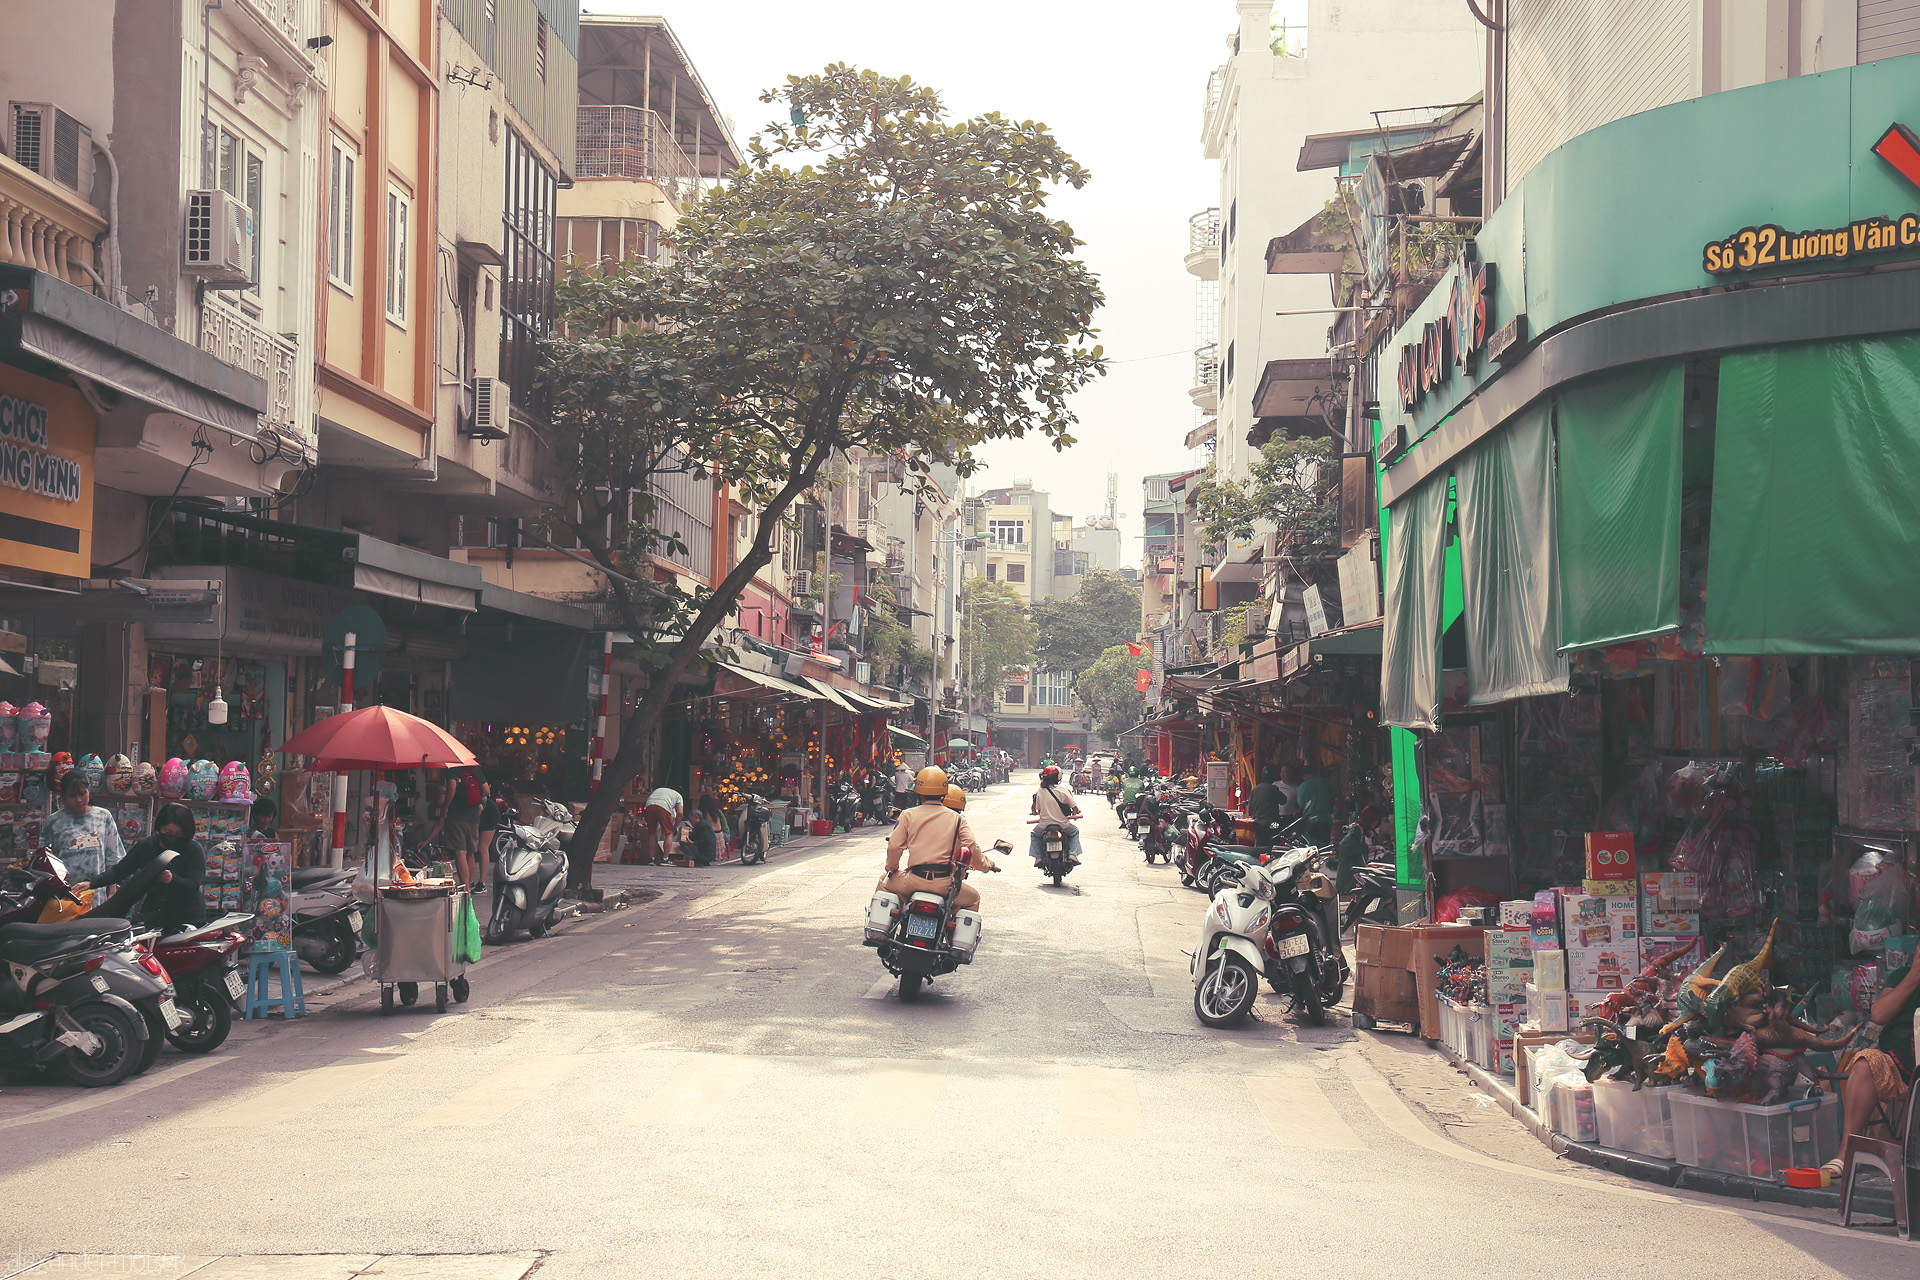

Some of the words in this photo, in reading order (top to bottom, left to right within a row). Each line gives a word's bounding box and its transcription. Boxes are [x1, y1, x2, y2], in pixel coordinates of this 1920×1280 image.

[1706, 237, 1737, 271] Số
[1738, 228, 1777, 267] 32
[1779, 231, 1849, 262] Lương
[1852, 221, 1896, 251] Văn
[1900, 216, 1920, 246] C
[0, 438, 32, 491] NG
[33, 451, 81, 503] MINH
[908, 925, 935, 937] 002.74
